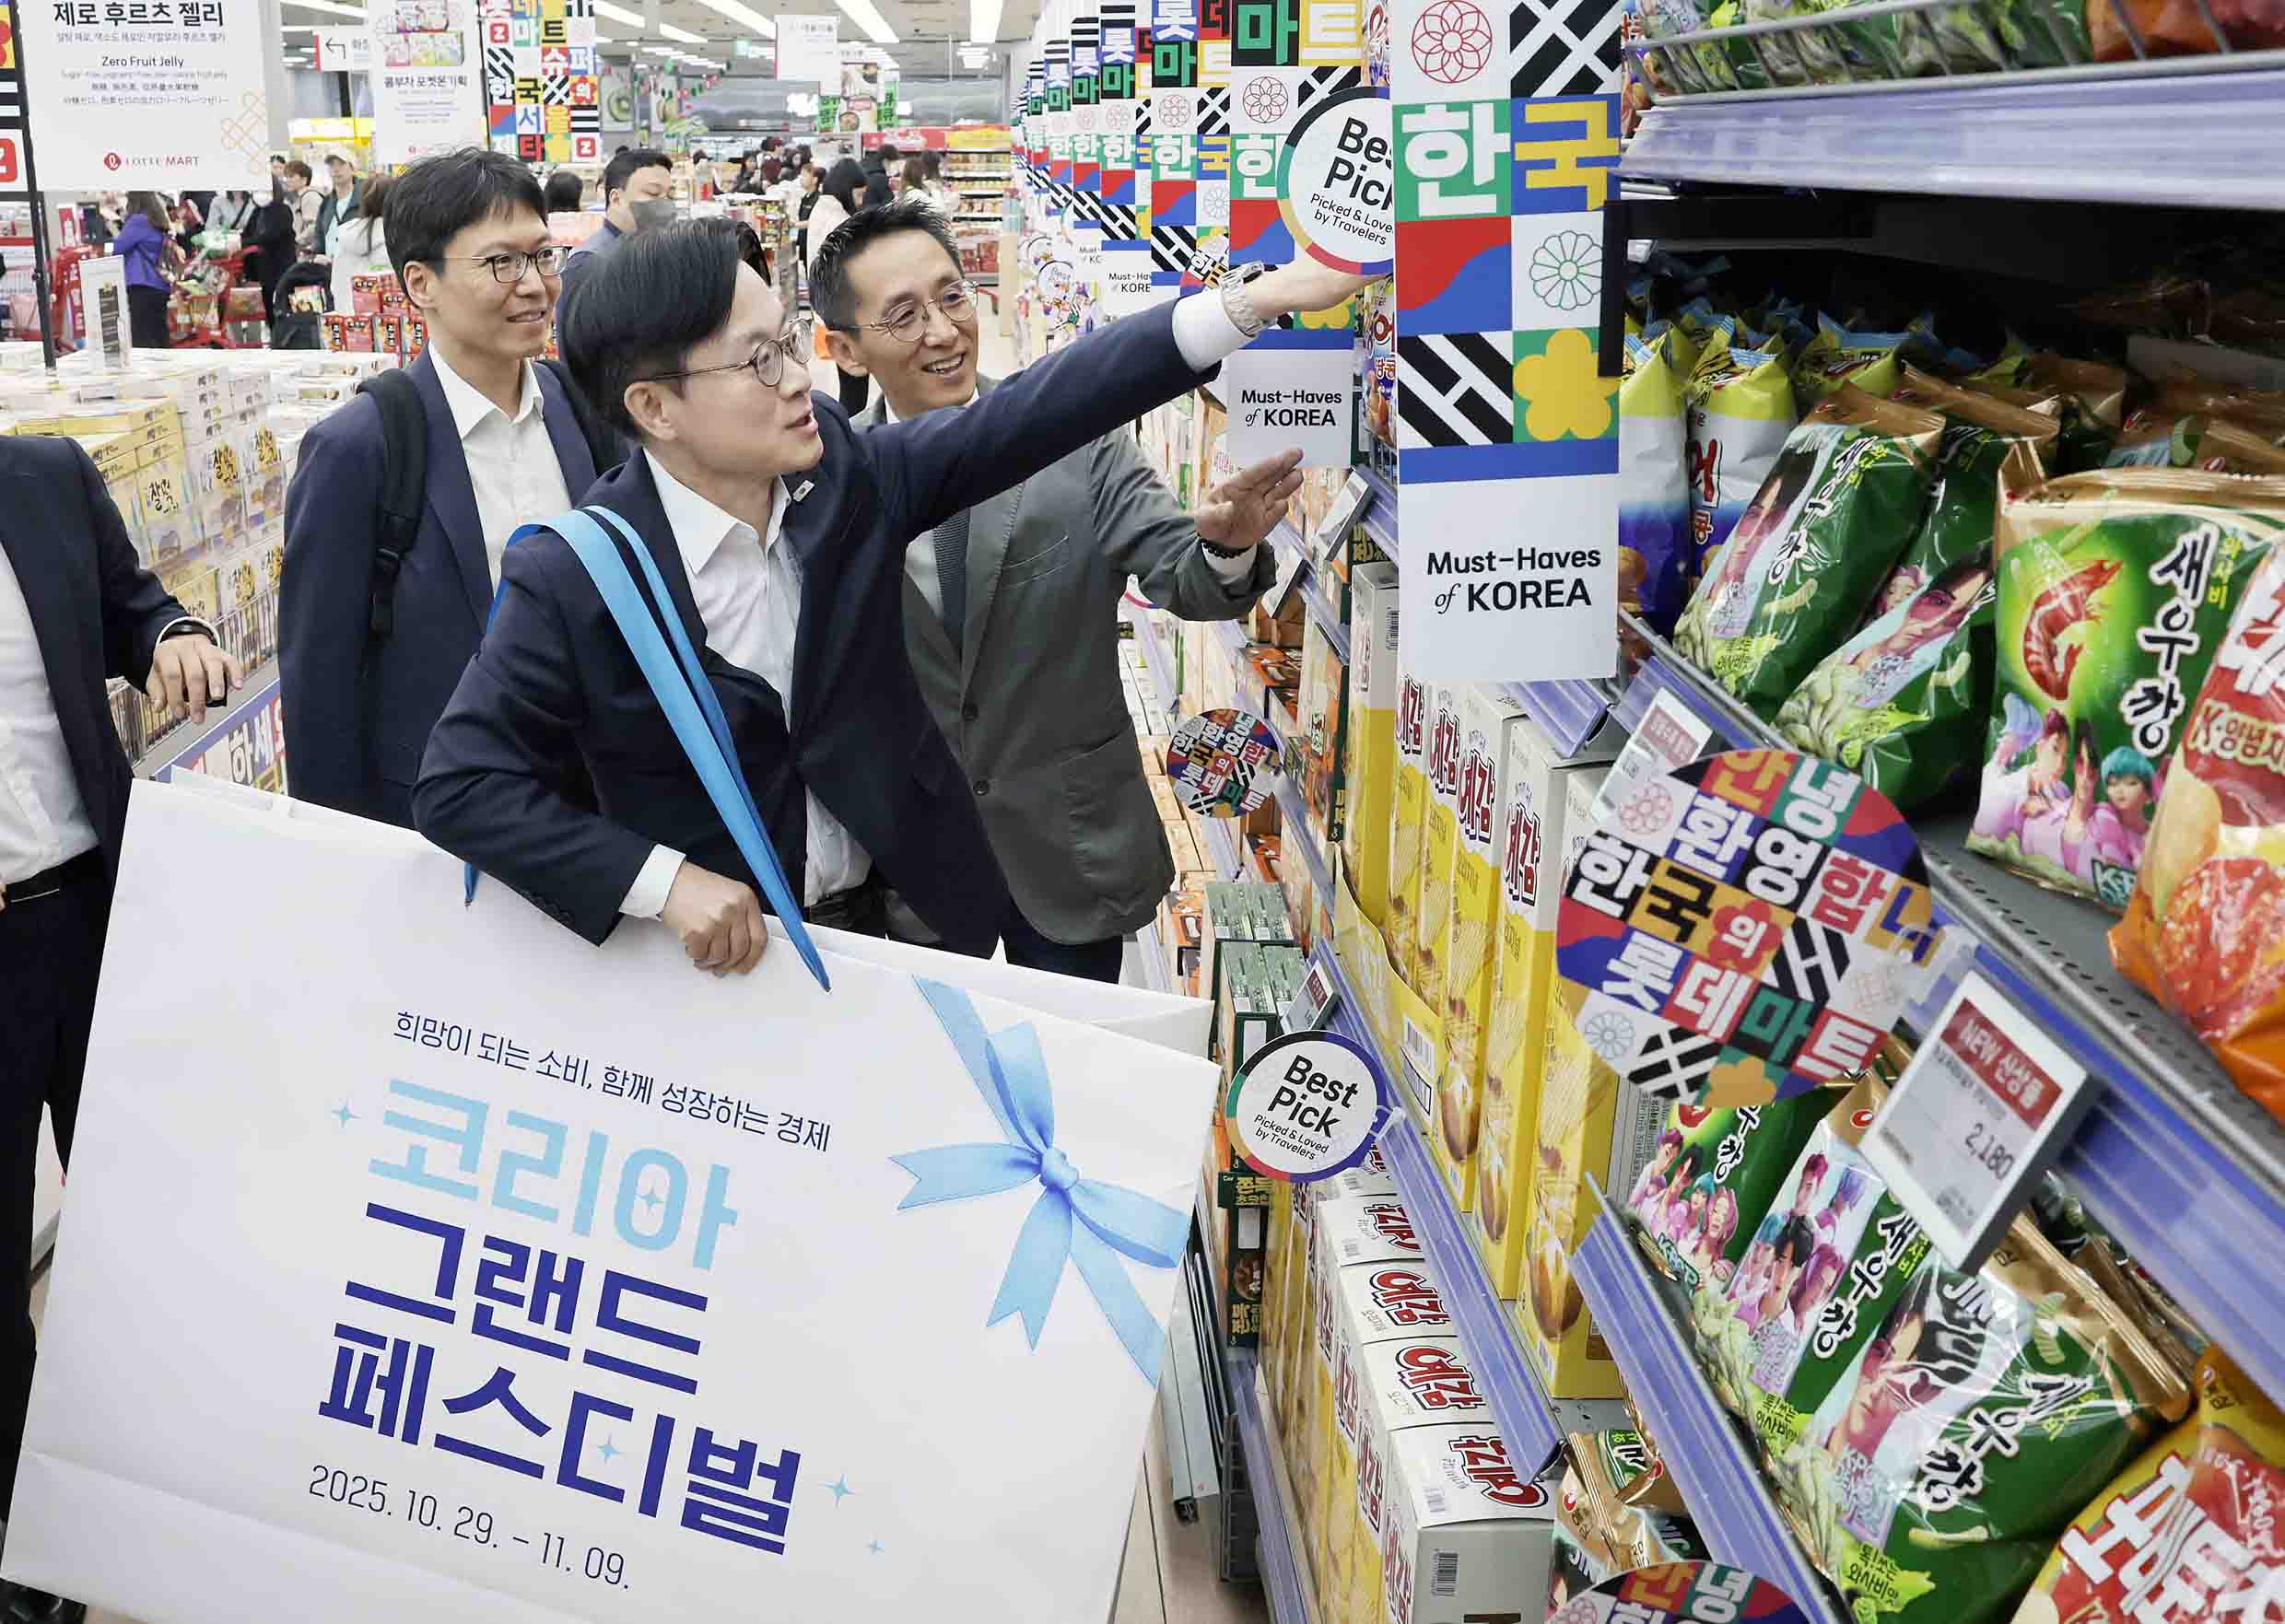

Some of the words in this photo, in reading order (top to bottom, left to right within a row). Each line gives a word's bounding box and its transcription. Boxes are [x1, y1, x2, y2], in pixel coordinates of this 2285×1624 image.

[54, 3, 99, 26] 제로
[104, 2, 173, 27] 후르츠
[179, 2, 223, 27] 젤리
[102, 56, 127, 66] Zero
[130, 56, 156, 66] Fruit
[159, 56, 184, 69] Jelly
[166, 155, 200, 167] MART
[1402, 100, 1621, 217] 한국
[1310, 193, 1352, 217] Picked
[1353, 210, 1362, 221] &
[1364, 214, 1392, 233] Love
[1314, 208, 1330, 226] by
[1332, 215, 1387, 245] Travelers
[1241, 390, 1342, 404] Must-Haves
[1245, 411, 1261, 427] of
[1263, 409, 1336, 426] KOREA
[1427, 547, 1601, 575] Must-Haves
[2208, 535, 2242, 610] 와사비
[1434, 581, 1460, 614] of
[1467, 578, 1592, 612] KOREA
[2123, 525, 2217, 755] 새우깡
[393, 1011, 472, 1057] 희망이
[477, 1032, 531, 1072] 되는
[536, 1050, 592, 1091] 소비,
[601, 1065, 654, 1105] 함께
[662, 1082, 769, 1134] 성장하는
[777, 1113, 831, 1152] 경제
[1282, 1055, 1359, 1109] Best
[1253, 1114, 1290, 1139] Picked
[1289, 1130, 1298, 1141] &
[1297, 1131, 1330, 1157] Loved
[1268, 1090, 1341, 1139] Pick
[1255, 1127, 1269, 1144] by
[1269, 1130, 1317, 1163] Travelers
[1964, 1122, 2016, 1181] 2,180
[369, 1078, 739, 1271] 코리아
[346, 1202, 708, 1395] 그랜드
[1813, 1212, 1917, 1359] 새우깡
[309, 1466, 393, 1516] 2025.
[407, 1490, 442, 1533] 10.
[454, 1506, 498, 1549] 29.
[542, 1533, 571, 1574] 11.
[584, 1548, 630, 1591] 09.
